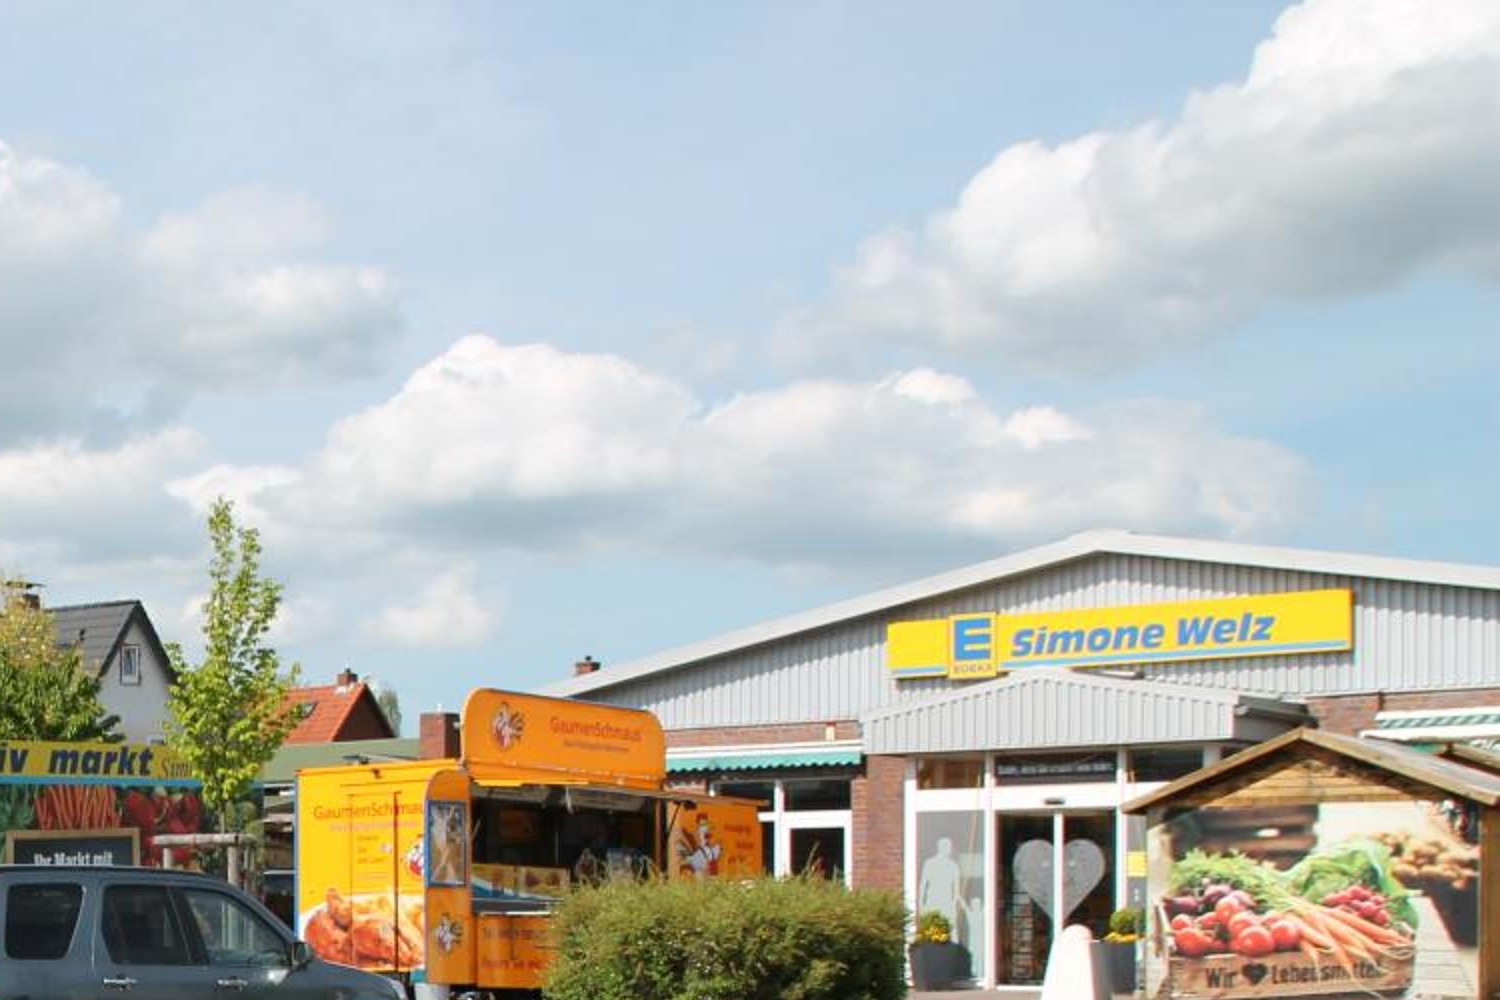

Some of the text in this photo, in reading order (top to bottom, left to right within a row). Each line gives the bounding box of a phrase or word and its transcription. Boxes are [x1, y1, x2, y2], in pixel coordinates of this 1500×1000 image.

[953, 612, 1276, 662] E Simone Welz
[953, 663, 993, 674] EDEKA
[48, 745, 155, 776] markt
[54, 851, 91, 865] Markt
[1204, 966, 1238, 989] Wir
